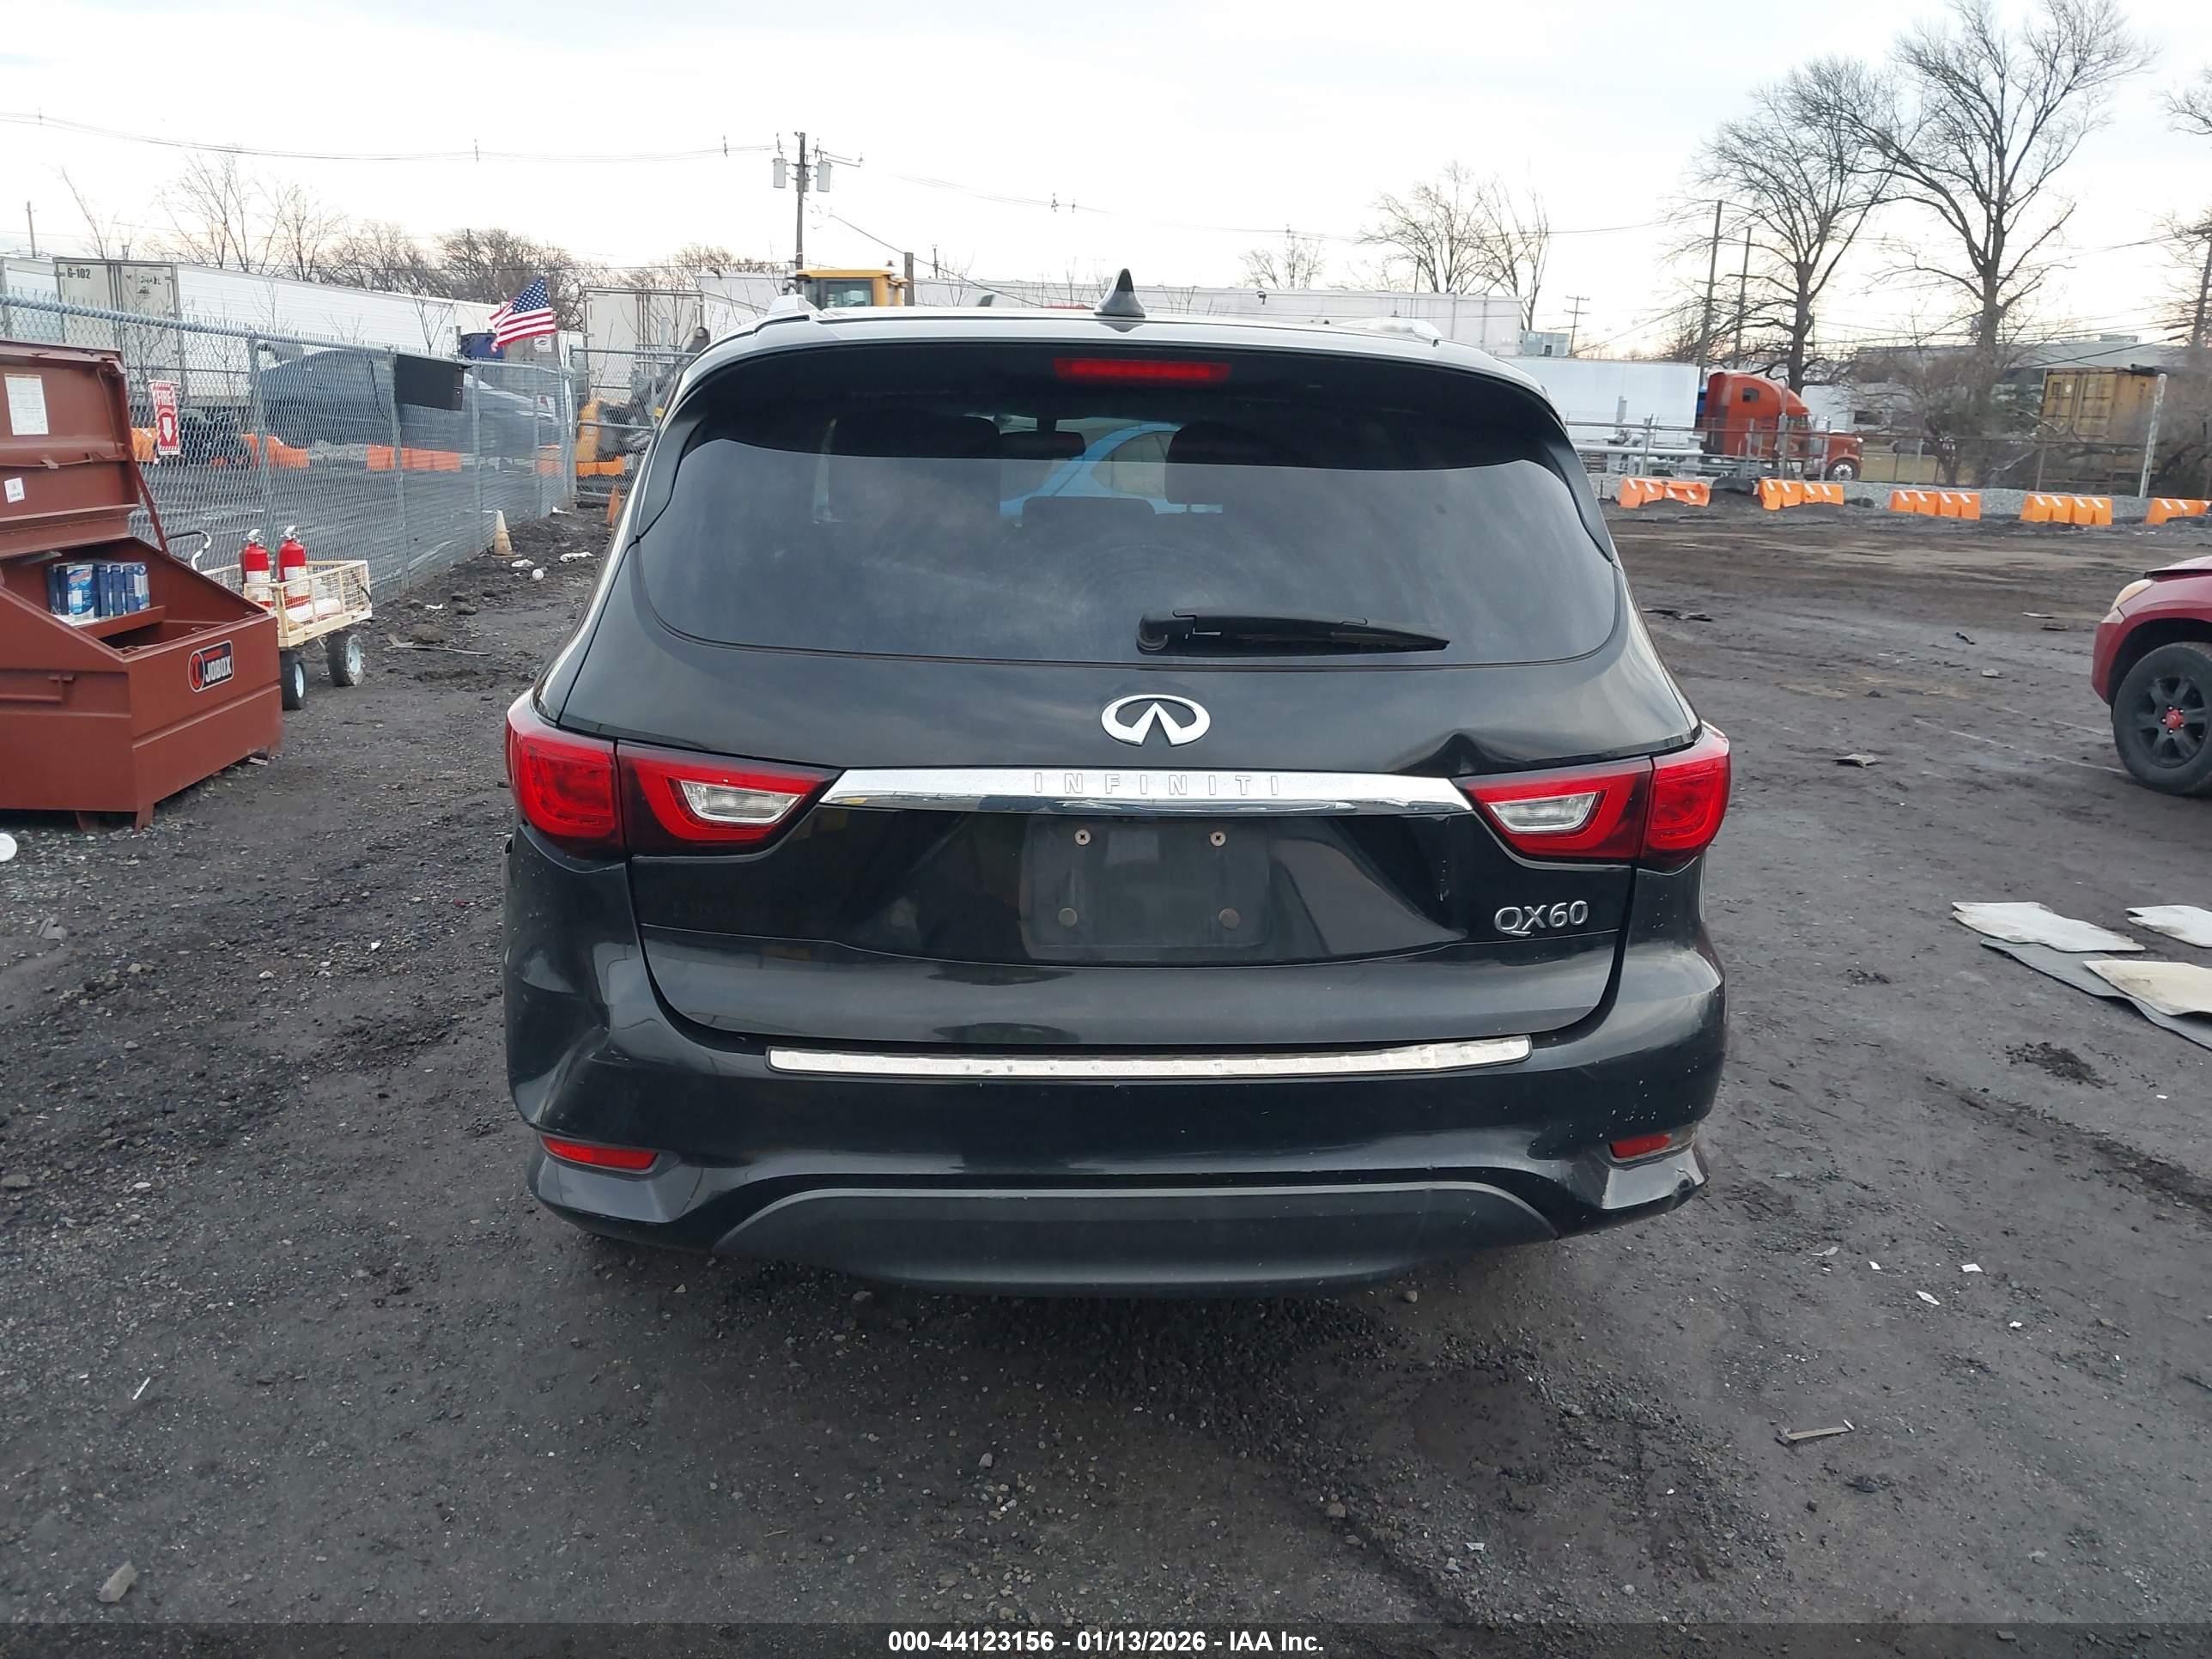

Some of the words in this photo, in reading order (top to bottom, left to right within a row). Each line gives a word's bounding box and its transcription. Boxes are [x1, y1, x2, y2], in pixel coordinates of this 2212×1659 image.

[67, 267, 91, 279] G-102
[155, 390, 174, 405] FIRE
[205, 655, 232, 683] JOBOX
[1034, 772, 1279, 796] INFINITI
[1493, 899, 1589, 936] QX60
